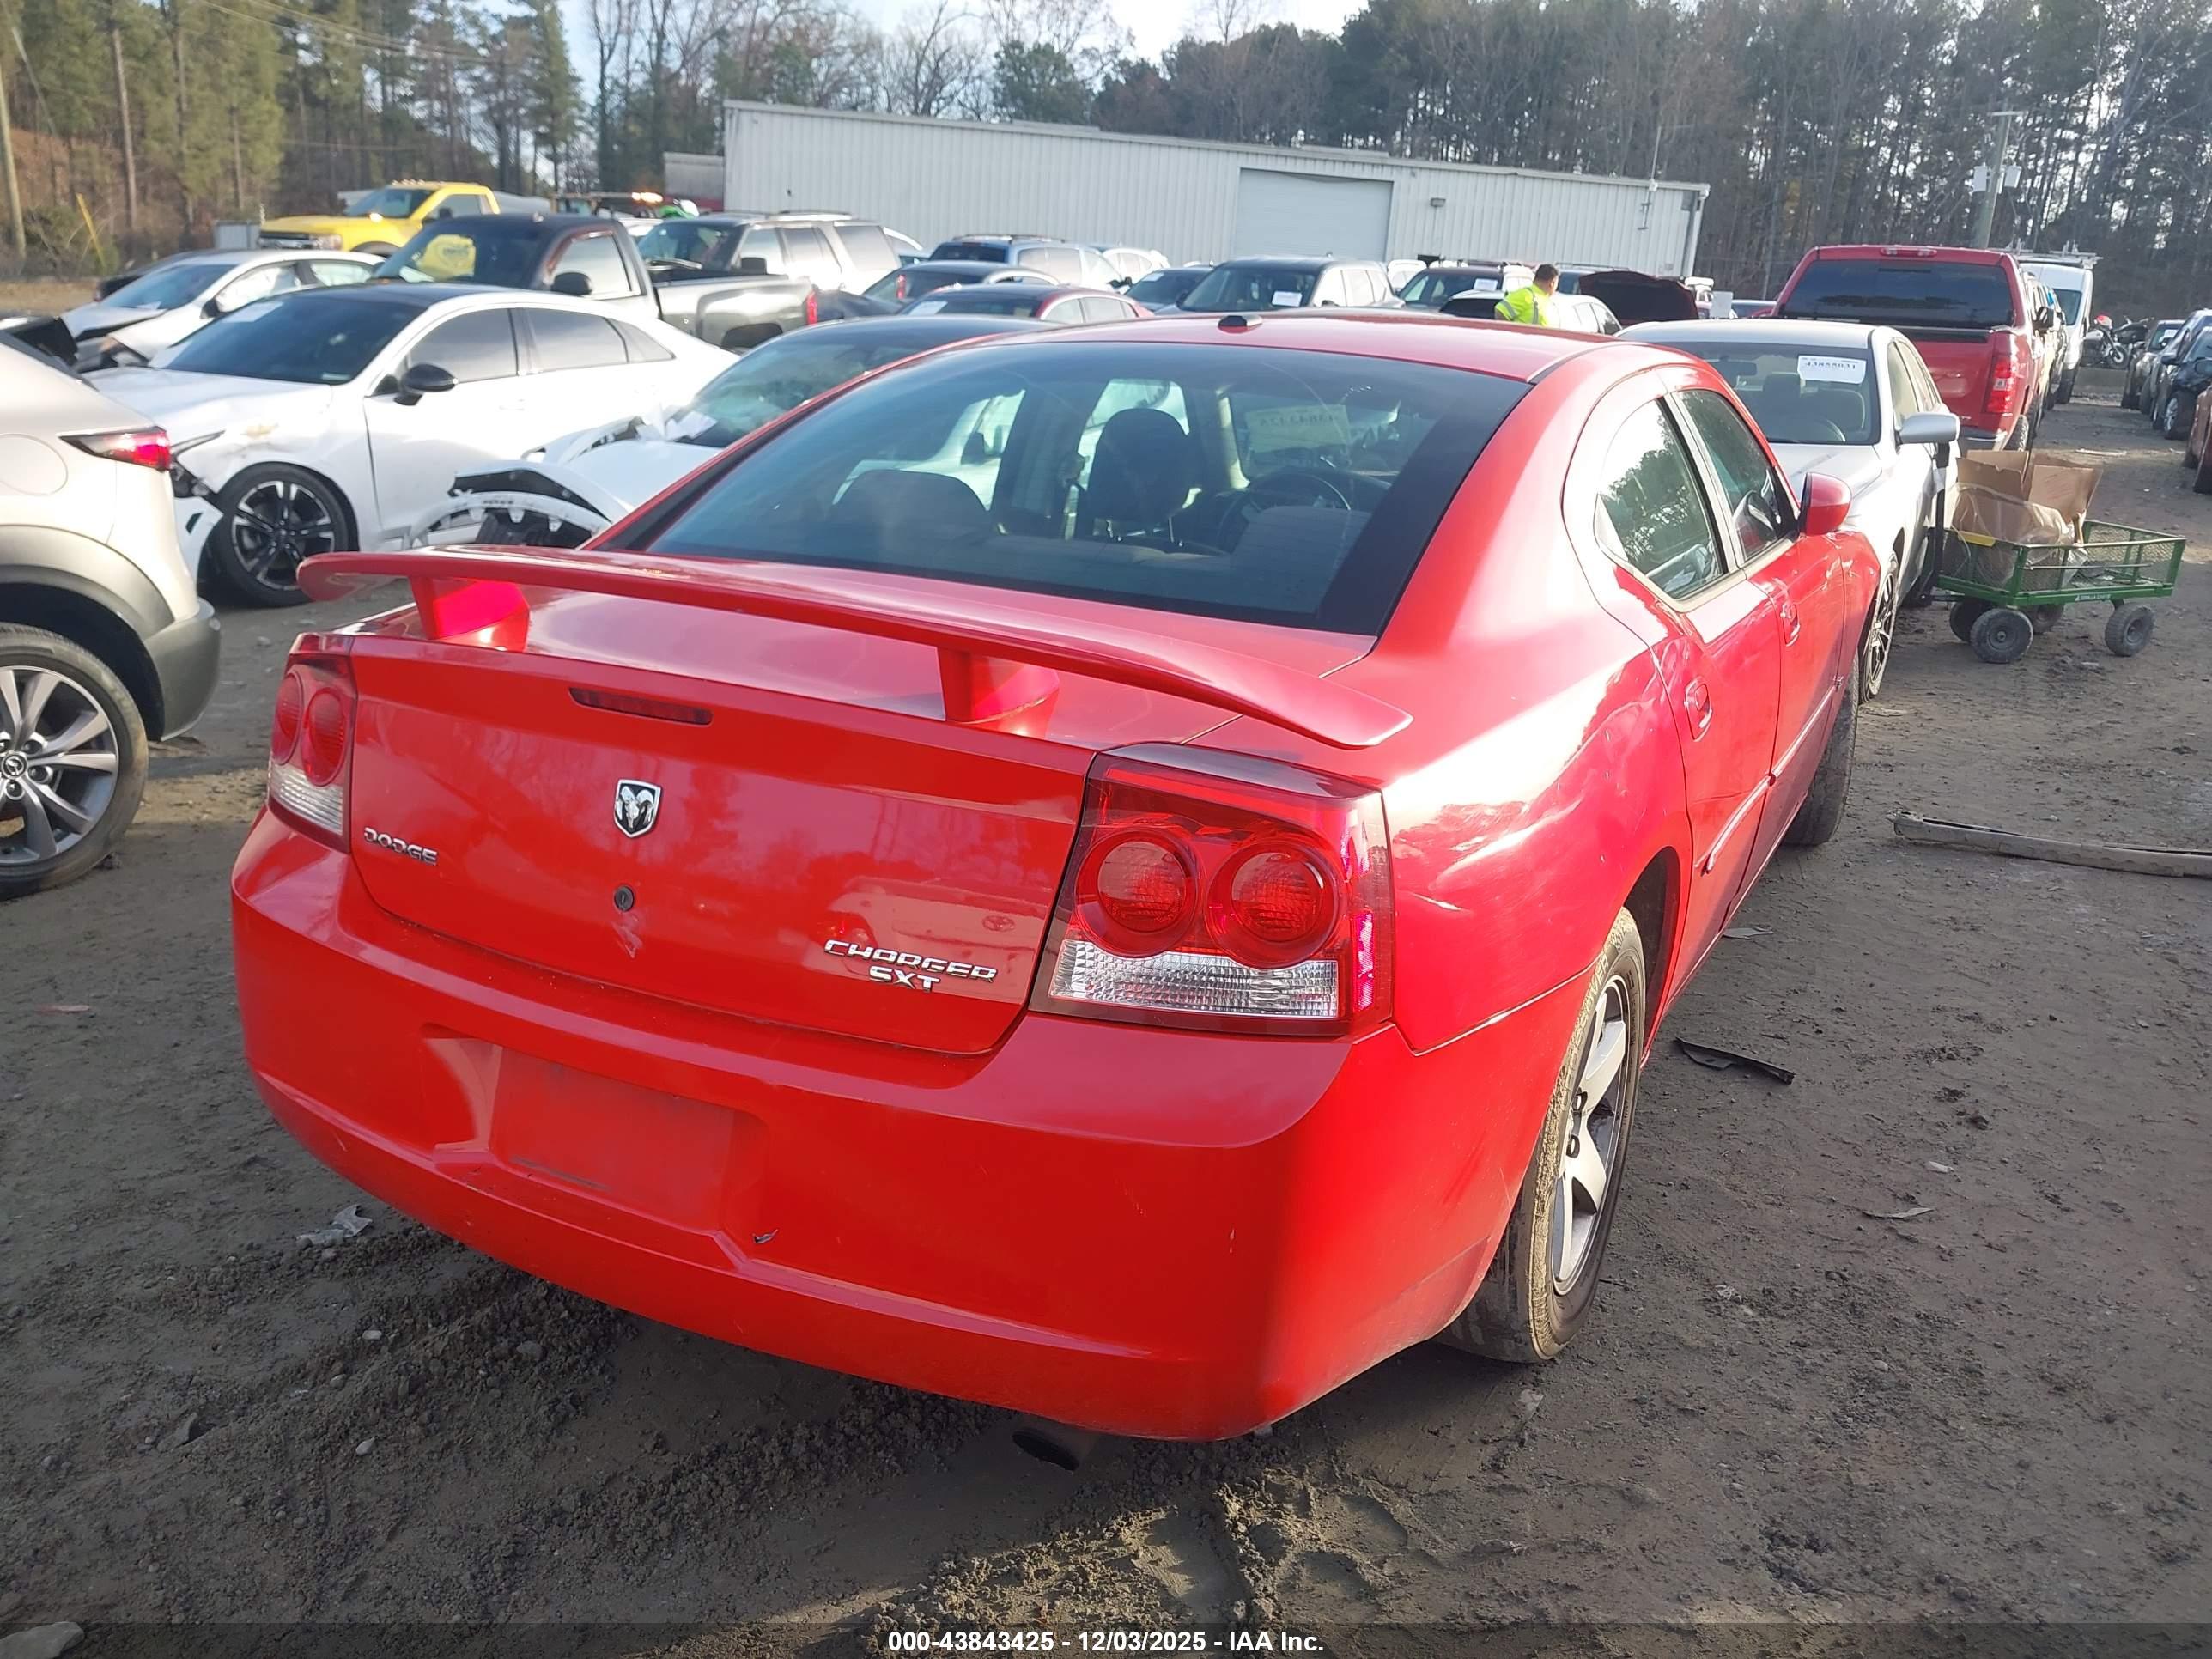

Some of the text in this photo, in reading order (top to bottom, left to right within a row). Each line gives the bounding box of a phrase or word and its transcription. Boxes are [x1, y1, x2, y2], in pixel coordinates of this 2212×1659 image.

[363, 827, 438, 866] DODGE
[823, 939, 998, 983] CHARGER
[869, 965, 940, 992] SXT
